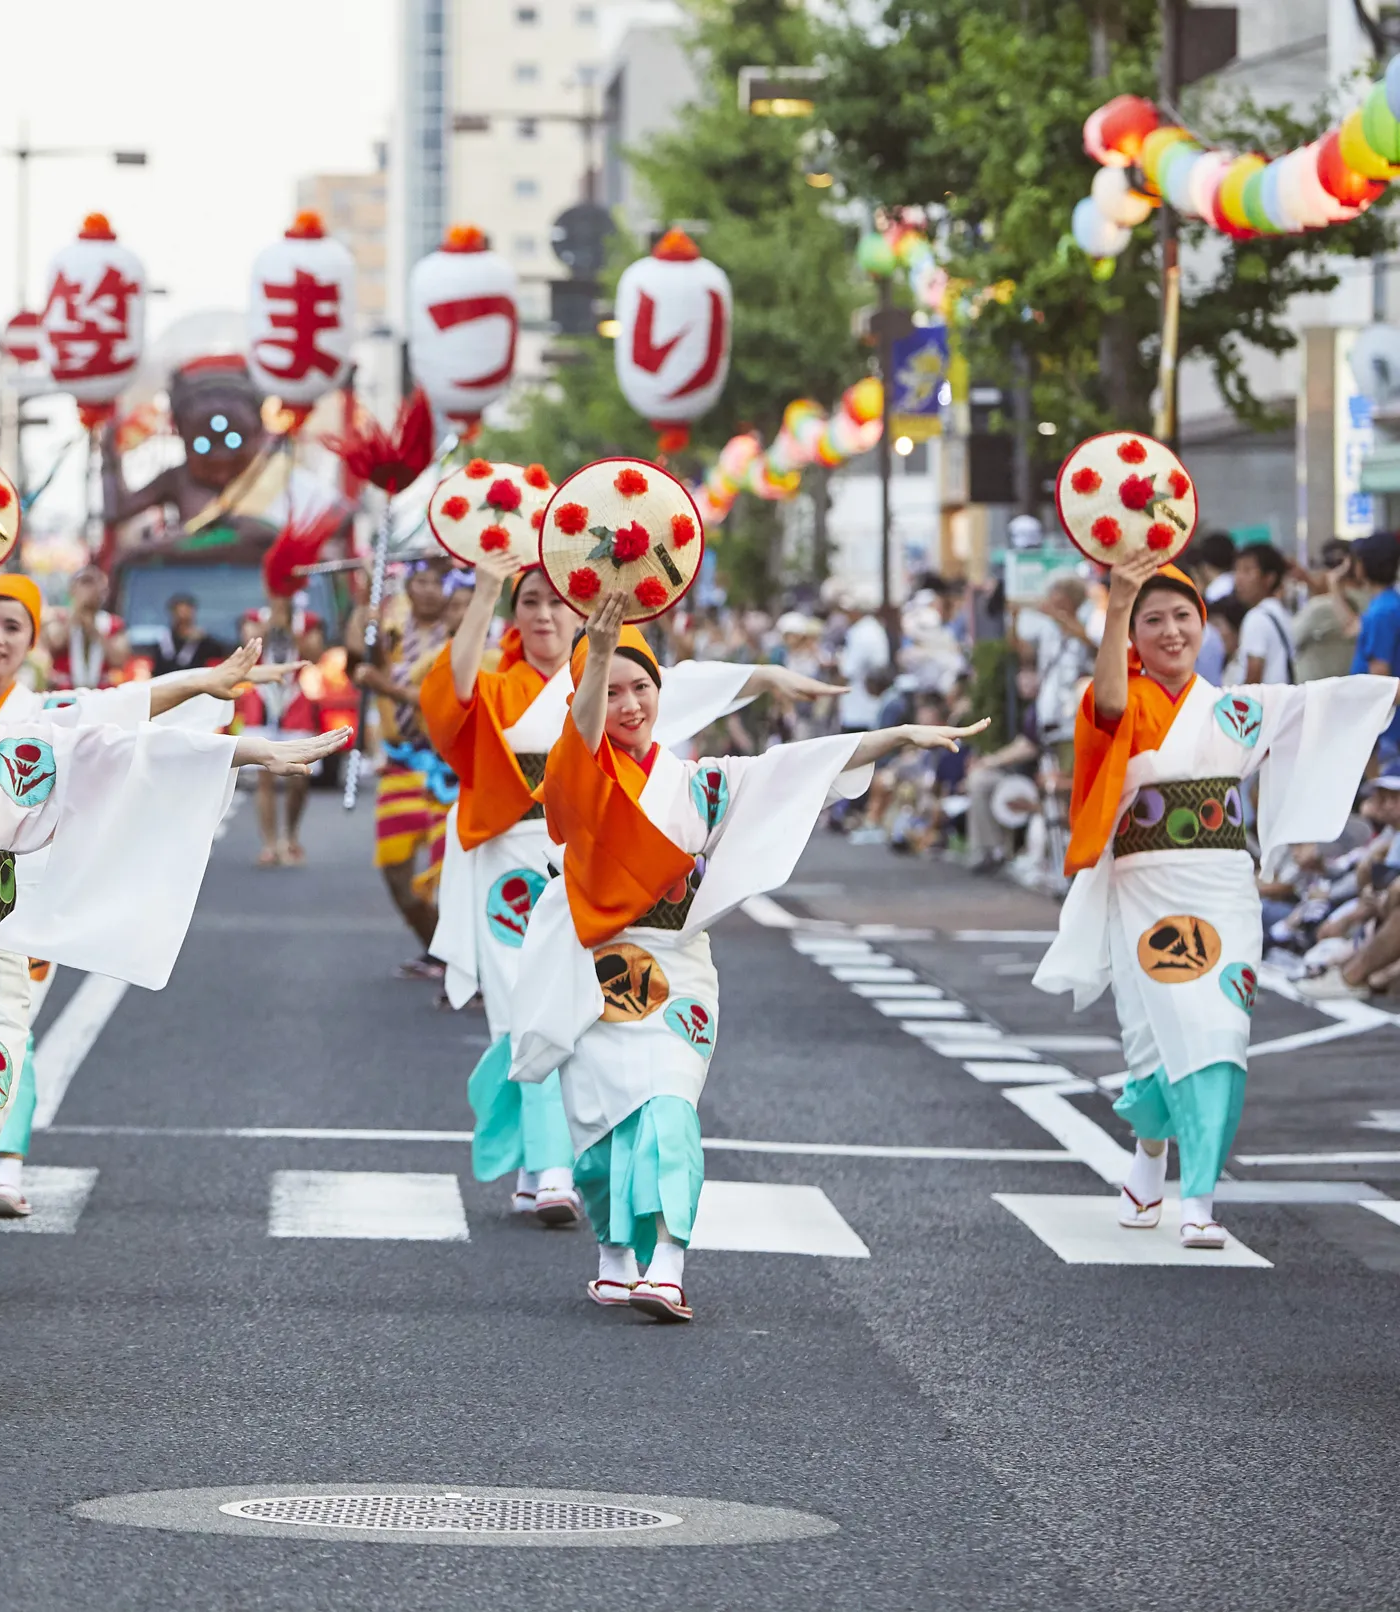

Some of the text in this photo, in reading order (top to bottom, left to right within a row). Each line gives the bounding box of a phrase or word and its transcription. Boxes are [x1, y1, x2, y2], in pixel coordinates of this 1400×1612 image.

[41, 264, 141, 382] 笠
[253, 268, 342, 381] ま
[428, 295, 518, 389] つ
[631, 289, 725, 398] り
